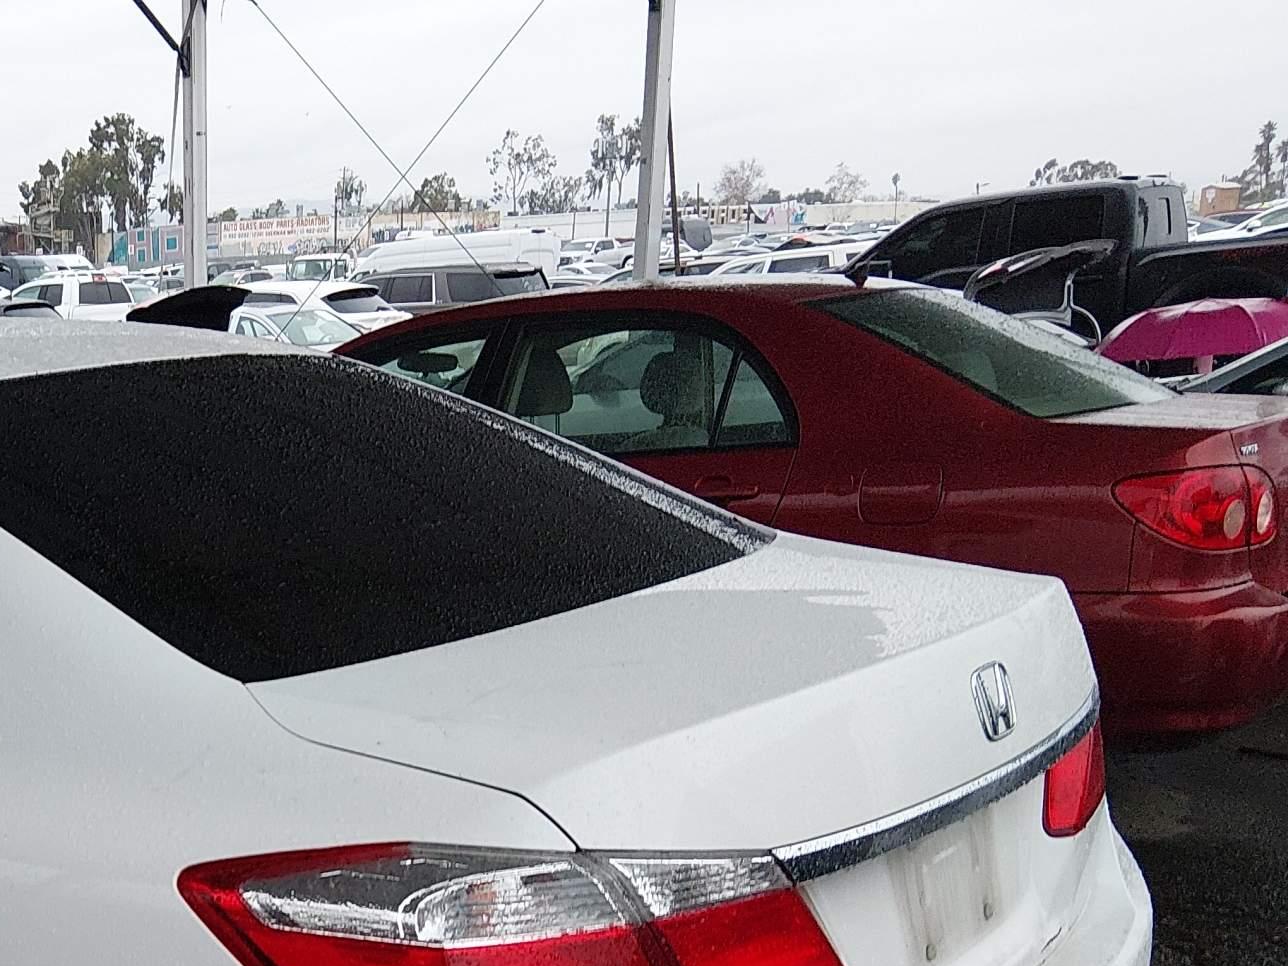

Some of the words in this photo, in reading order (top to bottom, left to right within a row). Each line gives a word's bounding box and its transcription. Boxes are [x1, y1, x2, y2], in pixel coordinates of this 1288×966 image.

[223, 223, 238, 232] AUTO
[239, 222, 257, 231] GLASS
[259, 221, 274, 230] BODY
